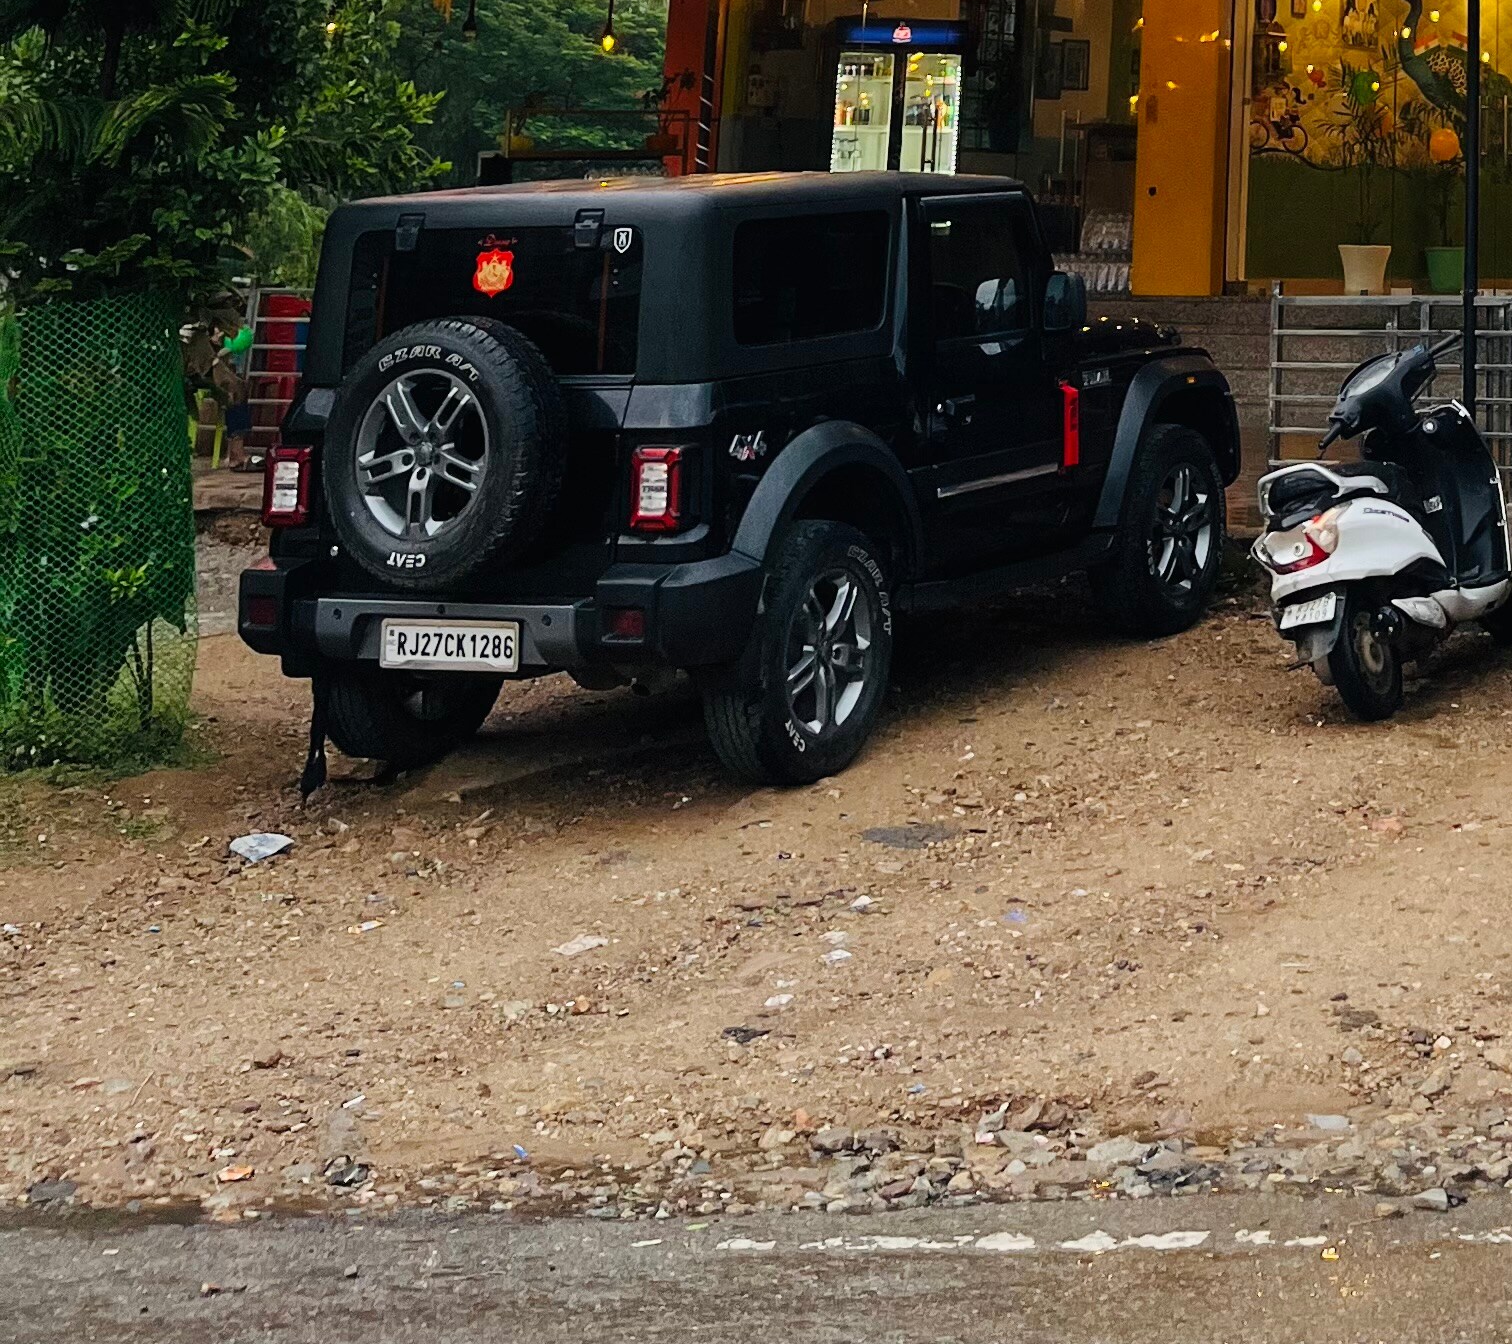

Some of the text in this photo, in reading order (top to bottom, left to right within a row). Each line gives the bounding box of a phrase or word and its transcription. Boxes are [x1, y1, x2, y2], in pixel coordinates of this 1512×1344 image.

[378, 344, 442, 373] CZAR
[386, 550, 427, 569] CEAT
[396, 631, 514, 660] RJ27CK1286
